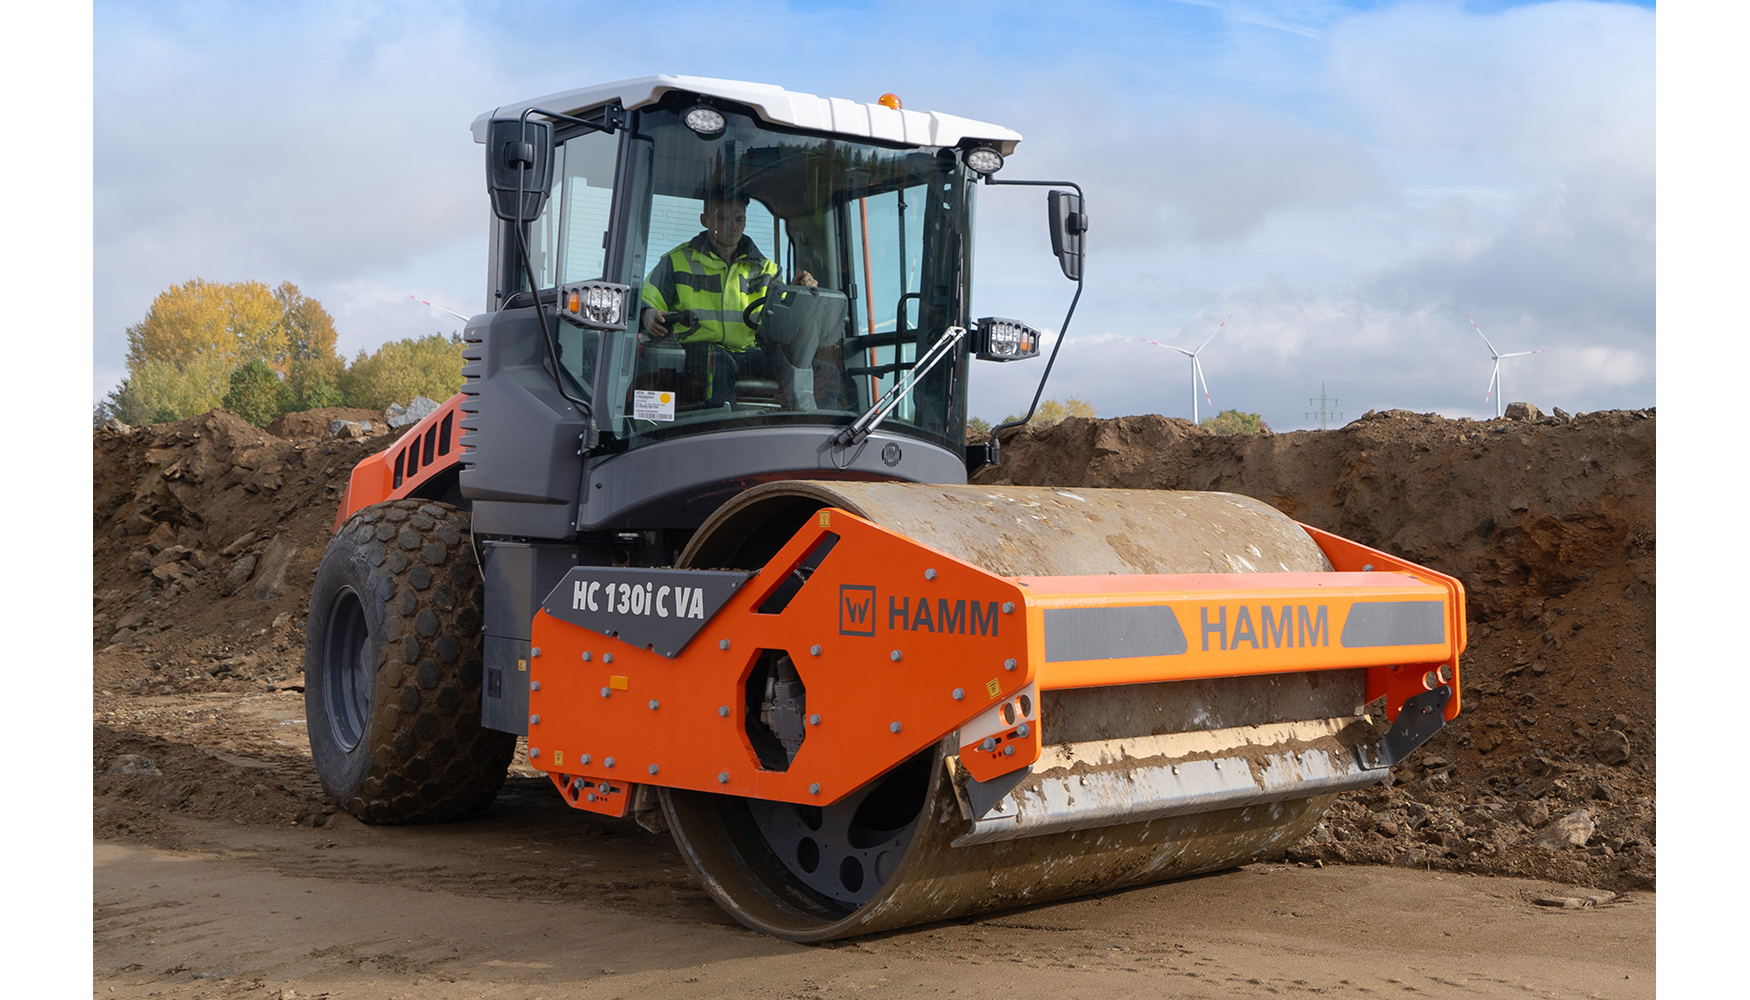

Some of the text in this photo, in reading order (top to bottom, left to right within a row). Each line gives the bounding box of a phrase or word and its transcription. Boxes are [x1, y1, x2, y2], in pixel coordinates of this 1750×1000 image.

[572, 580, 704, 619] HC 130i C VA
[888, 595, 999, 637] HAMM
[1200, 605, 1330, 652] HAMM
